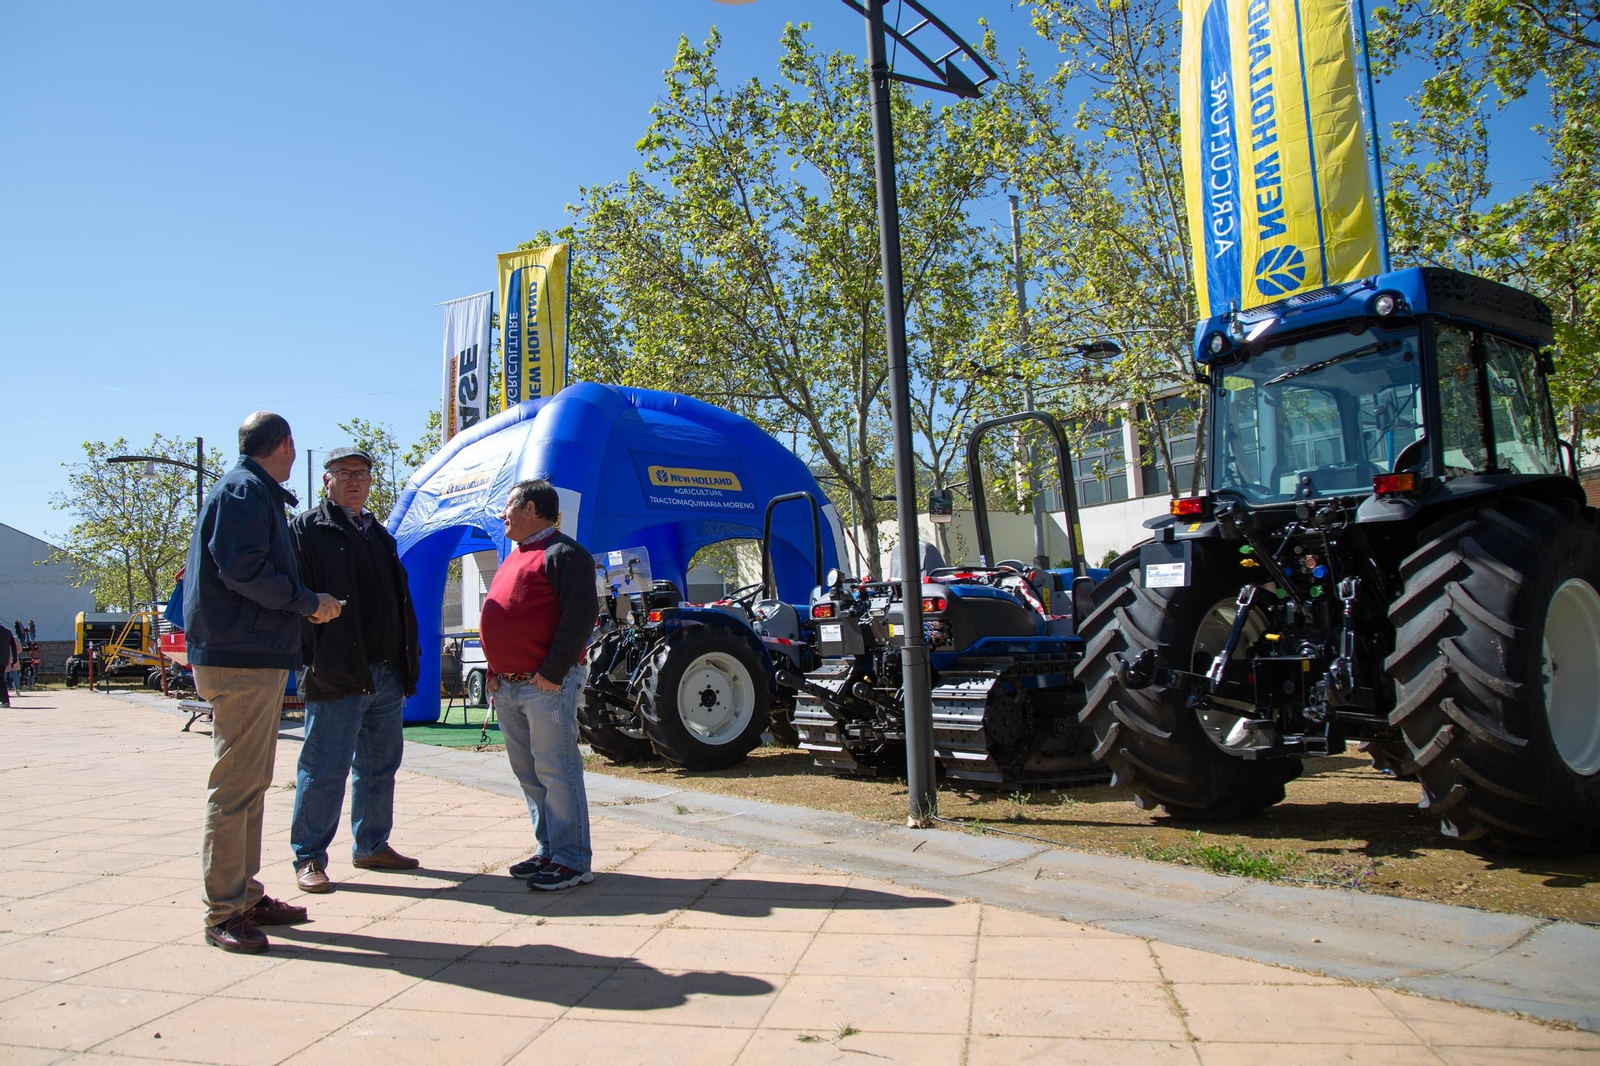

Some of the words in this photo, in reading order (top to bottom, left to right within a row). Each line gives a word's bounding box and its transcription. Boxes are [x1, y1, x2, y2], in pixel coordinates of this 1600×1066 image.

[670, 473, 690, 484] NEW
[691, 476, 733, 486] HOLLAND
[674, 488, 723, 496] AGRICULTURE
[649, 496, 723, 508] TRACTOMAQUINARIA
[723, 501, 755, 509] MORENO
